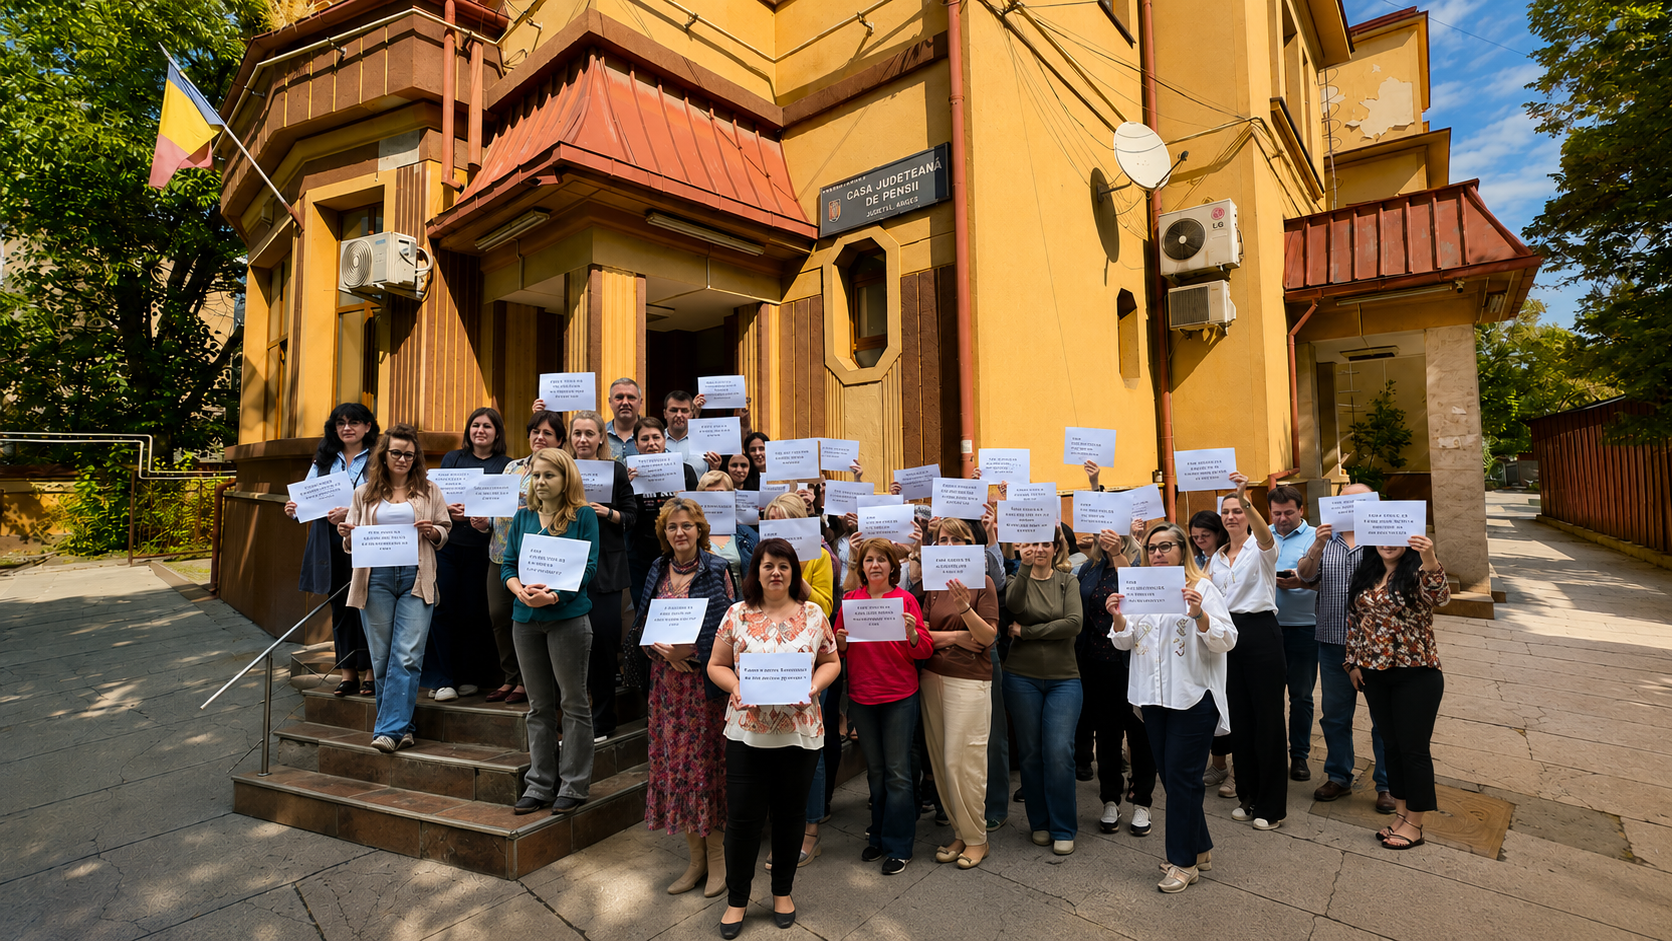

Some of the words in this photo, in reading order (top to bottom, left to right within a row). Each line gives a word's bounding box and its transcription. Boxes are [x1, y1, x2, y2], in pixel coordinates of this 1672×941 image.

[846, 185, 873, 201] CASA
[866, 193, 879, 207] DE
[883, 181, 919, 202] PENSII
[1212, 221, 1224, 229] LG
